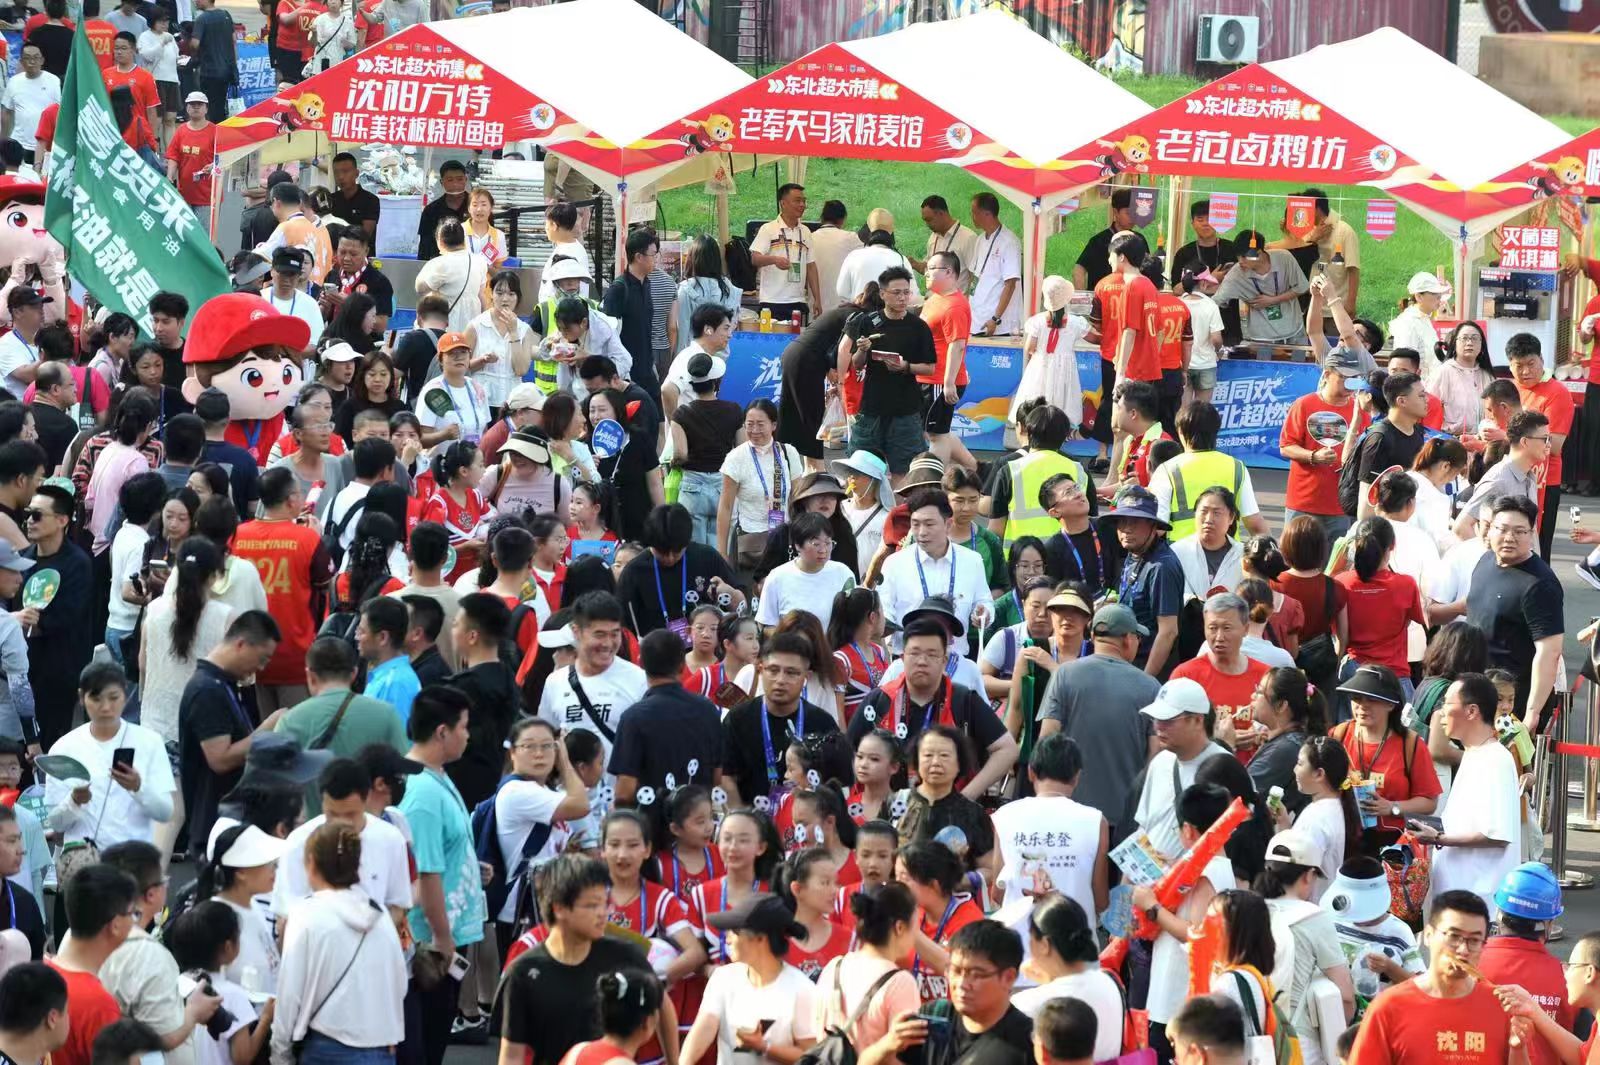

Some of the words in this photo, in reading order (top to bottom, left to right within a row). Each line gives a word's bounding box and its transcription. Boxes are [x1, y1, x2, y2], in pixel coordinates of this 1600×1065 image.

[373, 54, 465, 79] 东北超大市集
[346, 77, 492, 117] 沈阳方特
[784, 74, 879, 99] 东北超大市集
[1203, 95, 1301, 120] 东北超大市集
[739, 107, 924, 148] 老奉天马家烧麦馆
[1155, 128, 1348, 170] 老范卤鹅坊
[1501, 249, 1558, 268] 冰淇淋
[1014, 831, 1072, 848] 快乐老登
[1436, 1030, 1485, 1053] 沈阳
